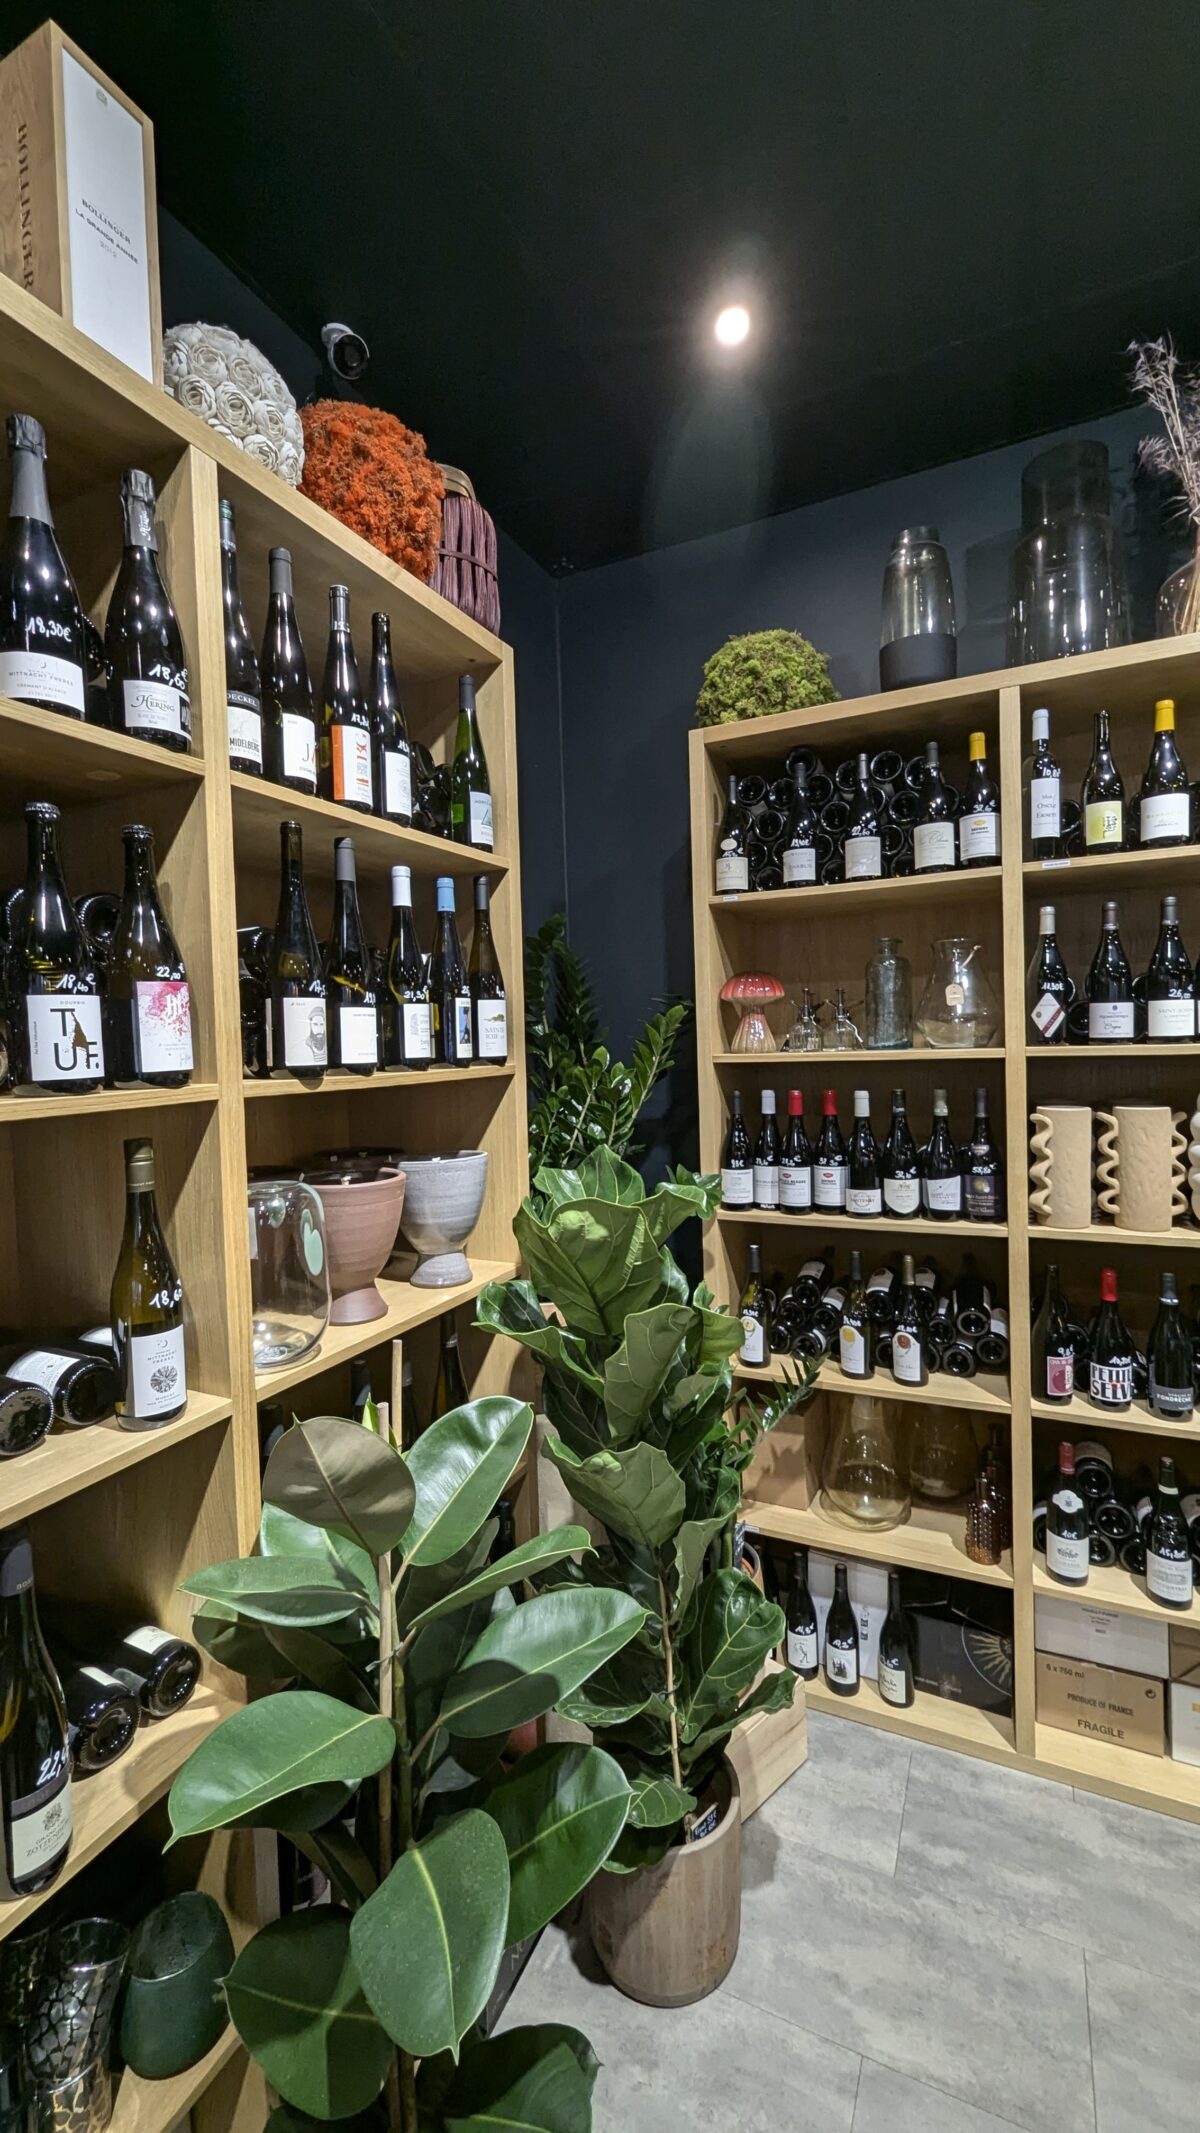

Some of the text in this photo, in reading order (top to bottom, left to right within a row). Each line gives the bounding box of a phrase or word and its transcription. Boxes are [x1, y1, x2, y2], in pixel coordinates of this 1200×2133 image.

[17, 123, 34, 290] BOLLINGER
[75, 208, 86, 220] LA
[81, 198, 131, 245] BOLLINGER
[25, 615, 73, 643] 18,30€
[1067, 1692, 1097, 1708] PRODUCE
[1107, 1702, 1135, 1717] FRANCE
[1077, 1718, 1126, 1740] FRAGILE
